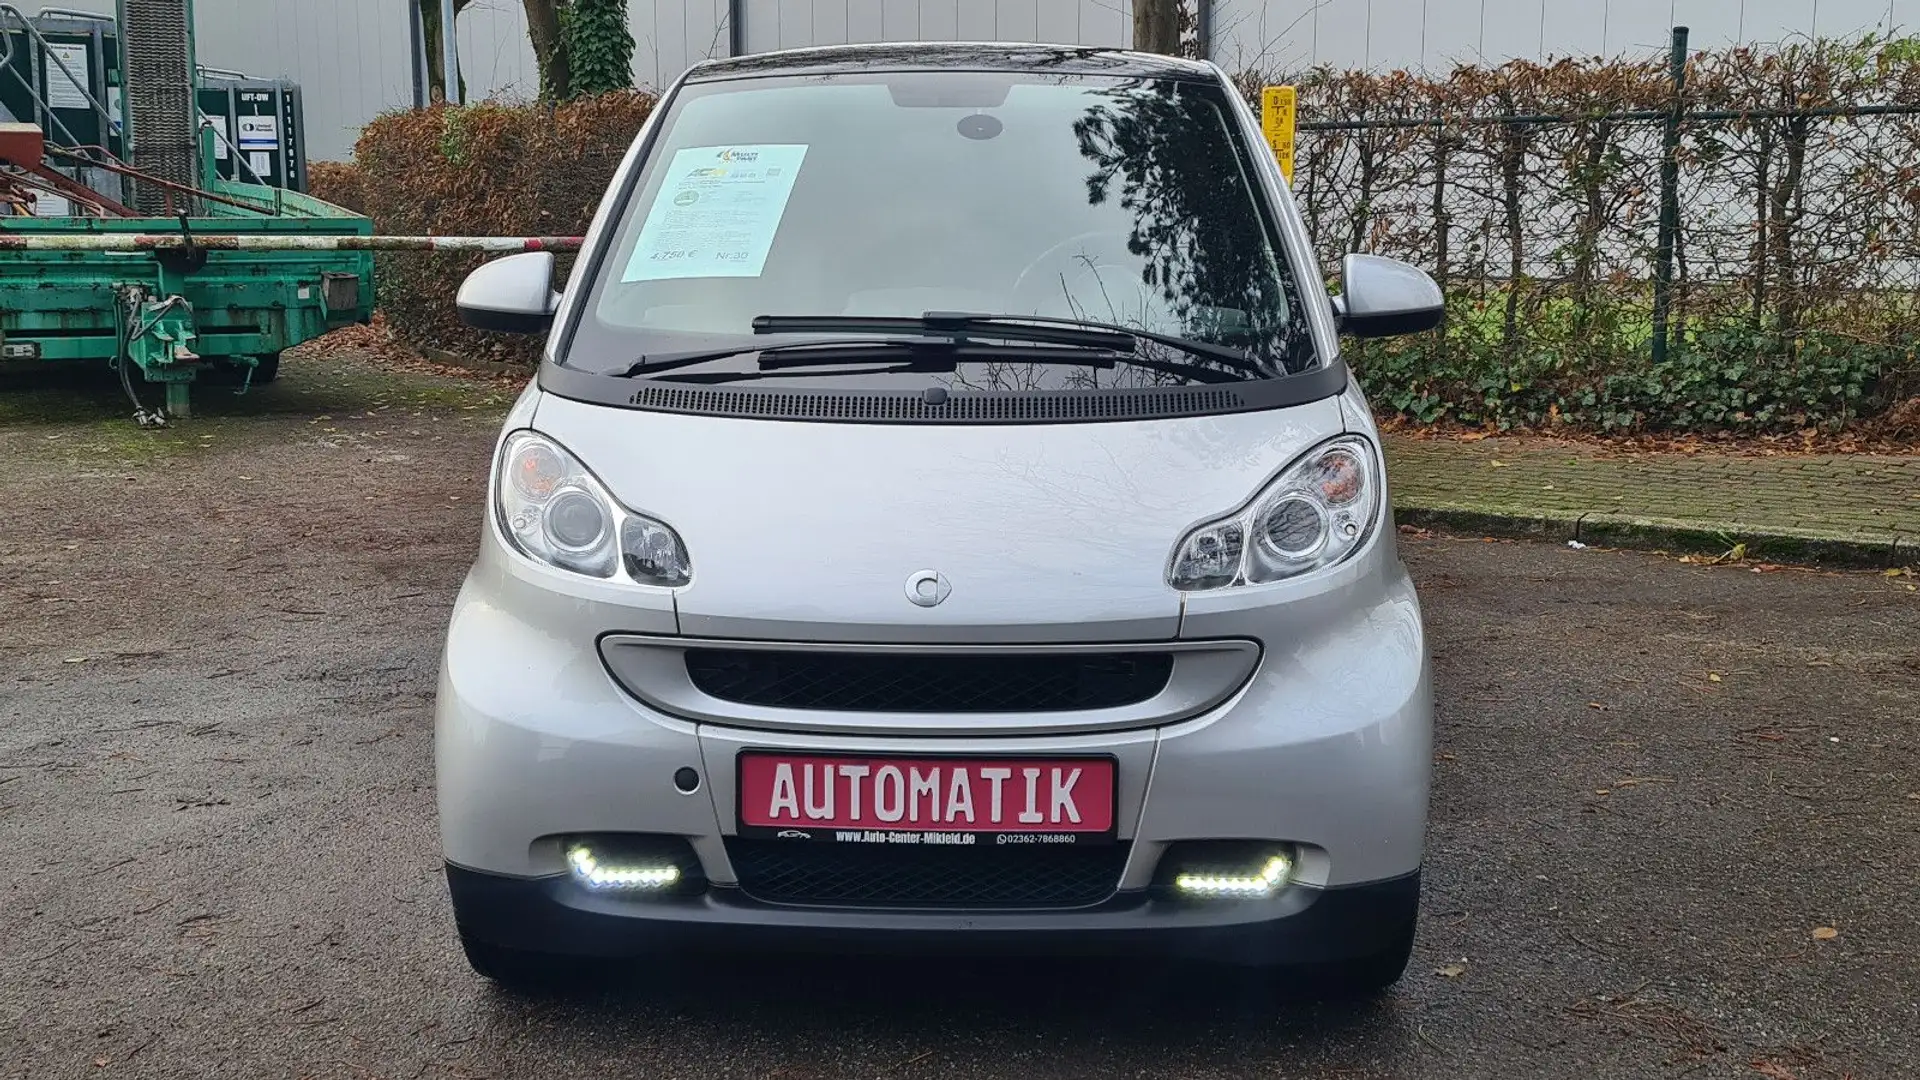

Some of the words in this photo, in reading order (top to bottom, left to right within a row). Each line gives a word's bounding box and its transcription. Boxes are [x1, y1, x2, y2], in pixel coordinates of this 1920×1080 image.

[768, 762, 1083, 825] AUTOMATIK
[835, 831, 976, 845] www.Auto-Center-Mikfeld.de
[1007, 833, 1076, 844] 02362-7868860
